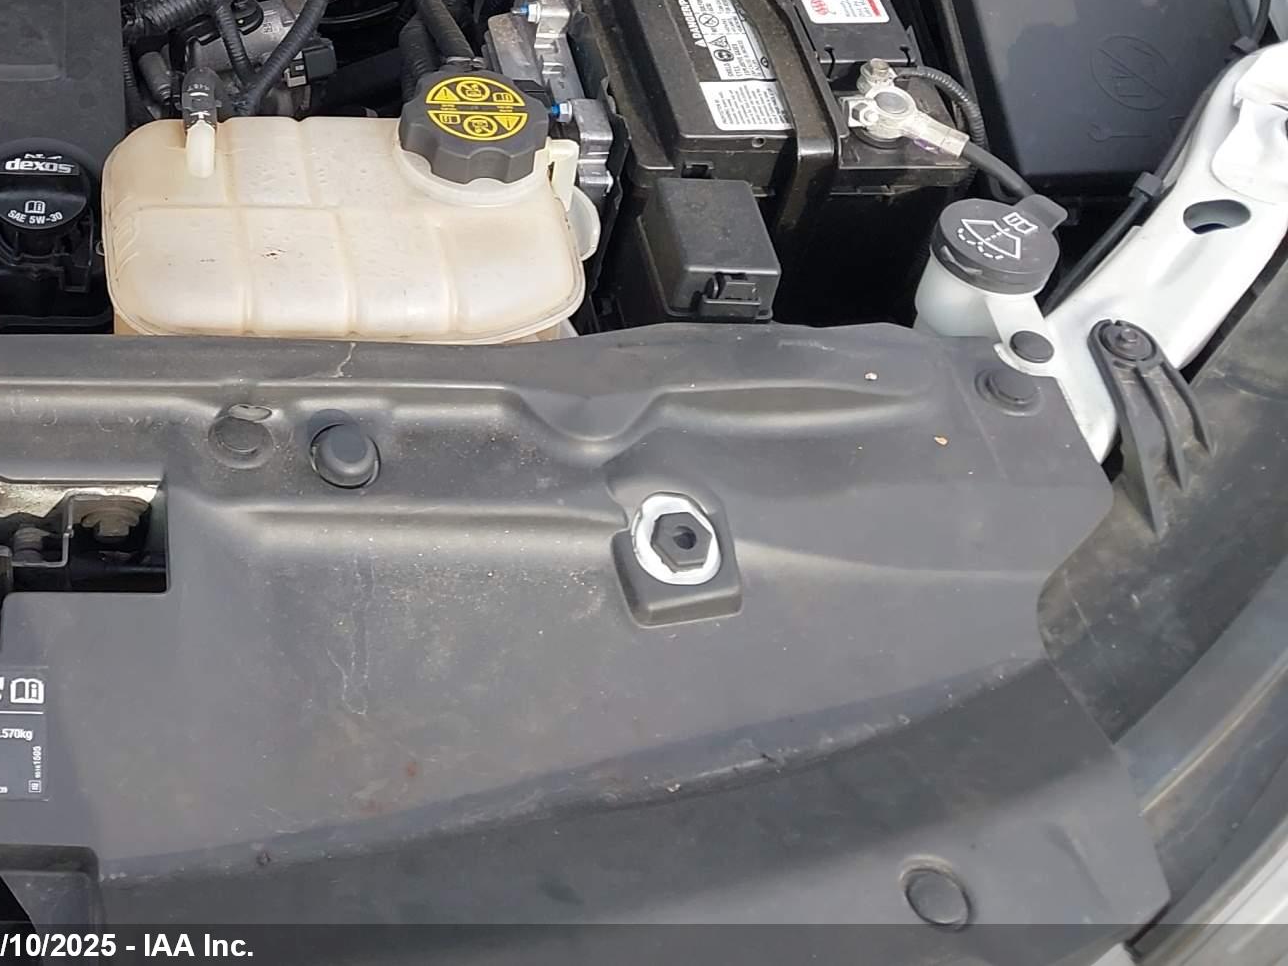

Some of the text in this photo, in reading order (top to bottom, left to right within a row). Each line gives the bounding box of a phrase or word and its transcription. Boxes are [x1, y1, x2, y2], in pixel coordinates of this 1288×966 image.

[5, 158, 75, 173] dexos
[8, 210, 63, 224] SAE 5W-30
